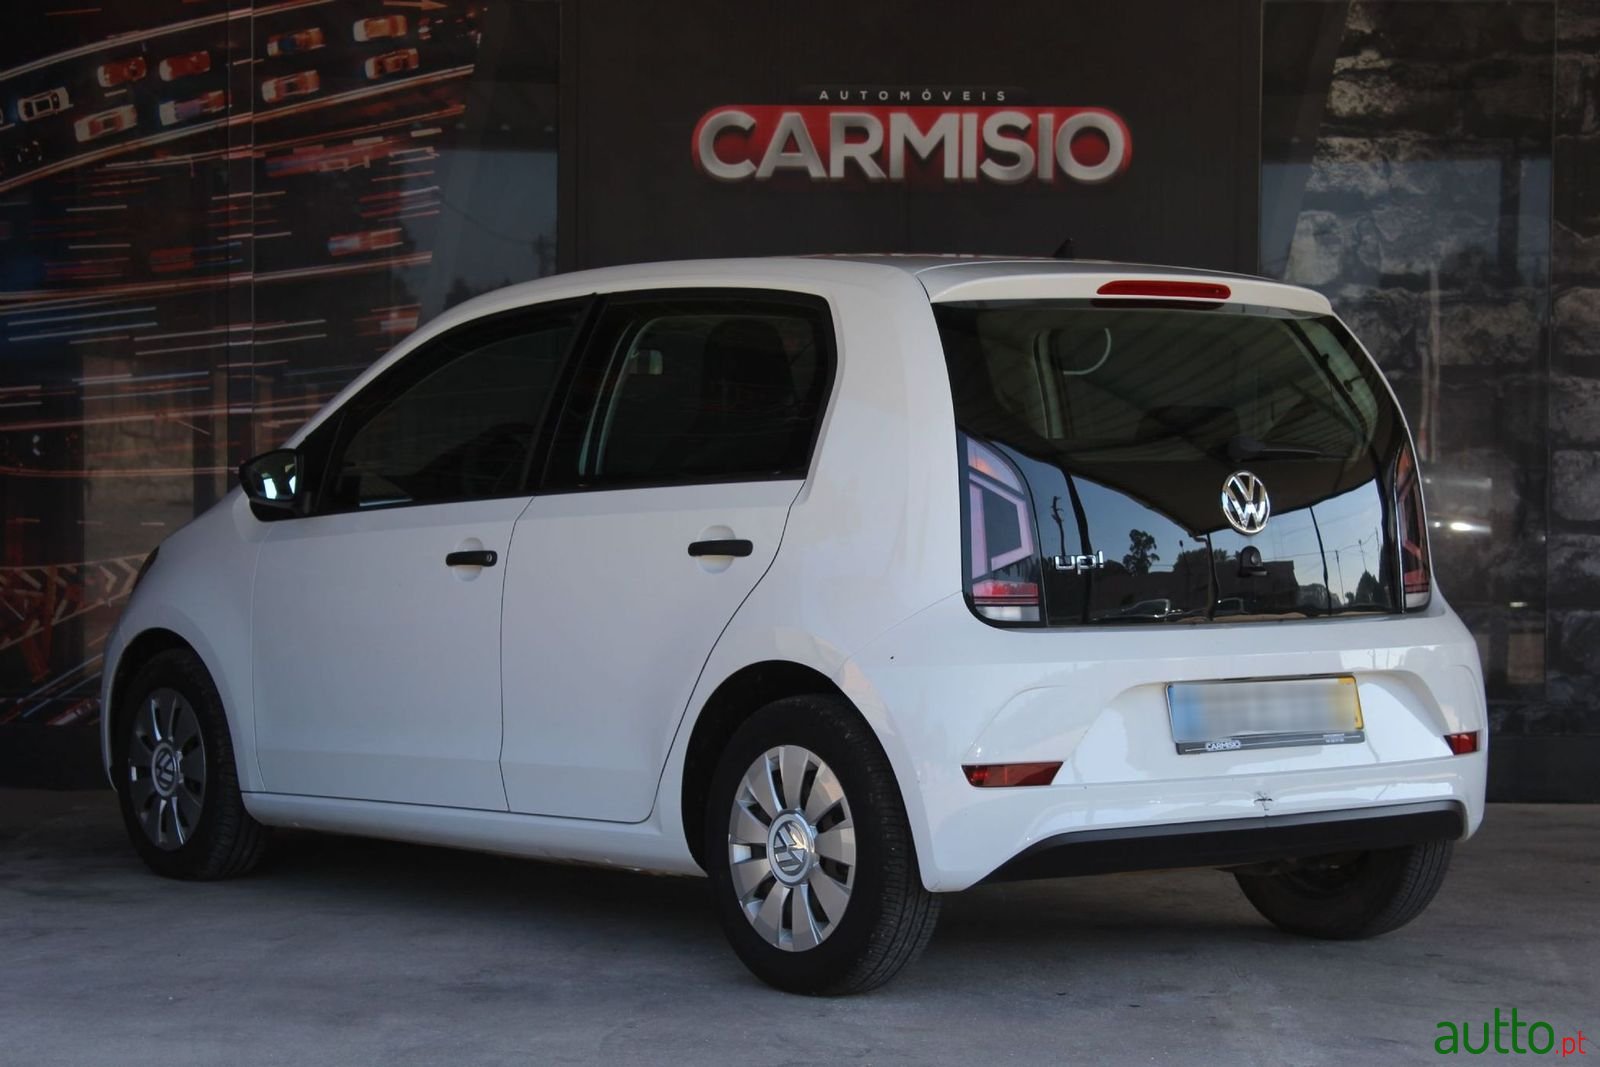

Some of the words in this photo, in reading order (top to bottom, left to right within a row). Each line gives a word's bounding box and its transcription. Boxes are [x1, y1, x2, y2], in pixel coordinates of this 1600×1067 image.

[819, 89, 1006, 101] AUTOMÓVEIS
[699, 110, 1126, 182] CARMISIO
[1054, 550, 1104, 575] up!
